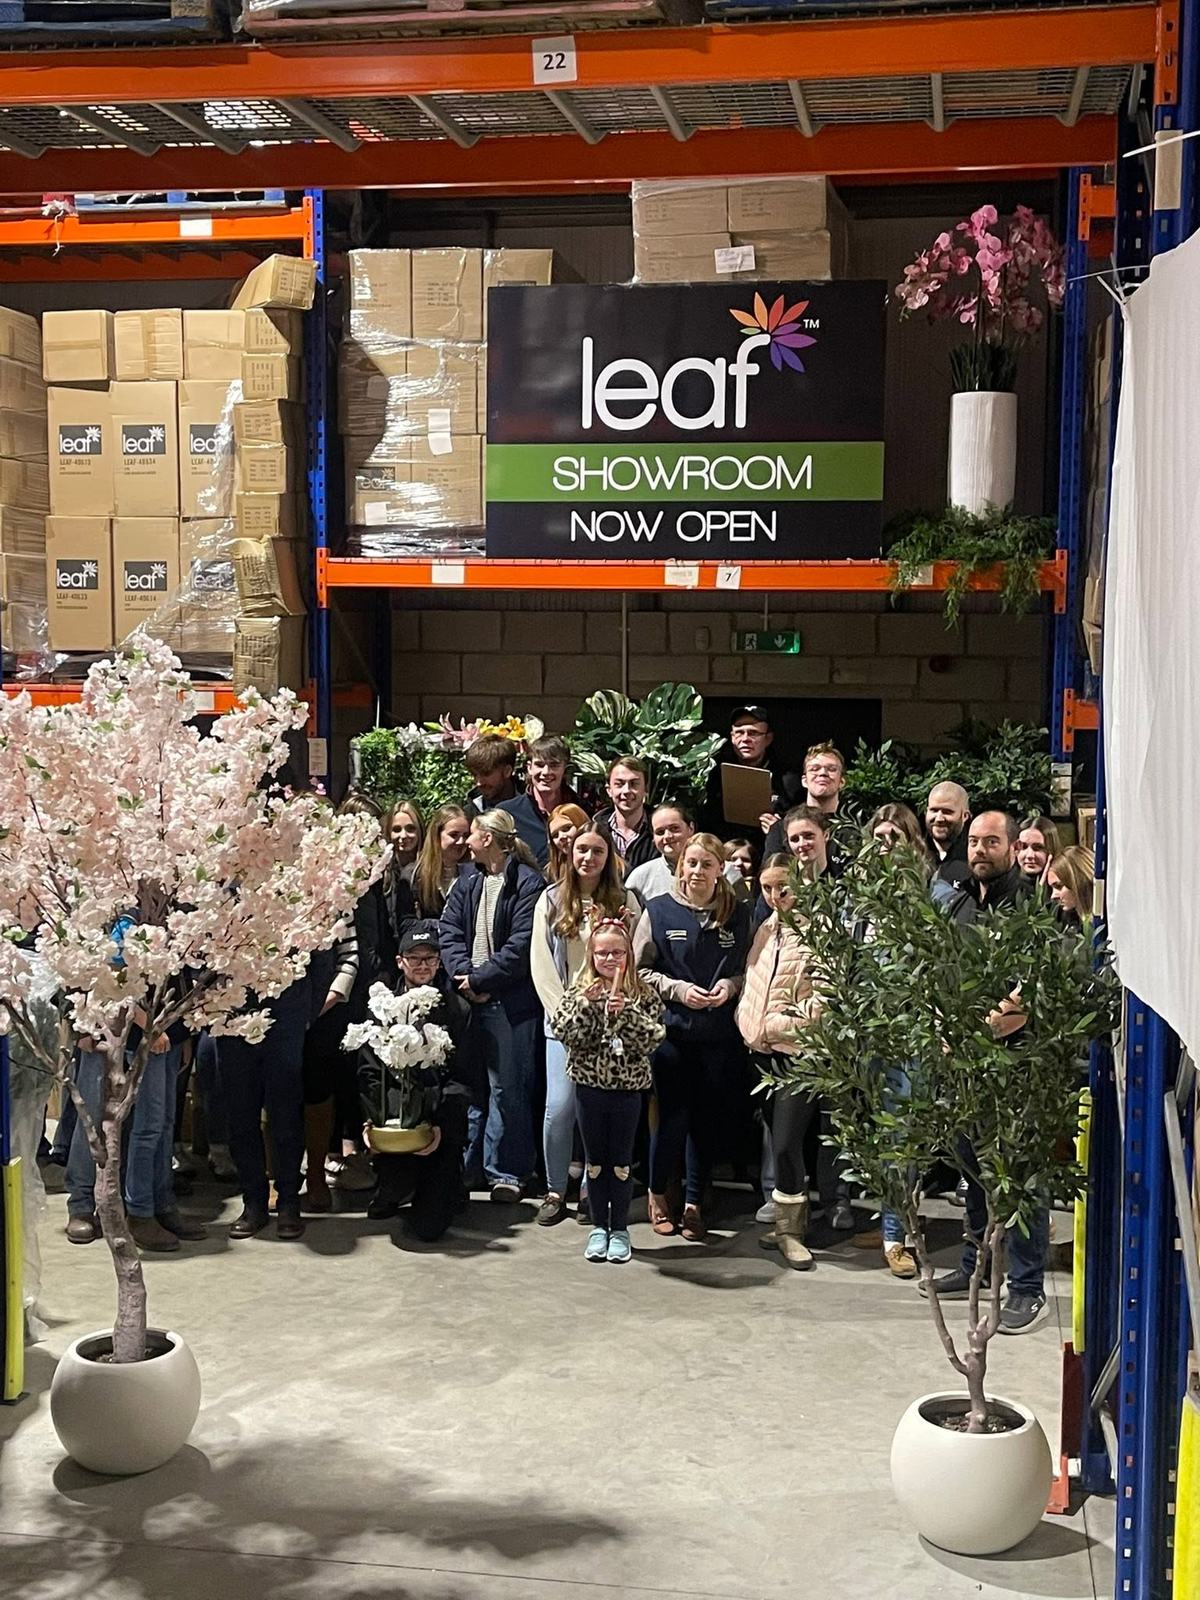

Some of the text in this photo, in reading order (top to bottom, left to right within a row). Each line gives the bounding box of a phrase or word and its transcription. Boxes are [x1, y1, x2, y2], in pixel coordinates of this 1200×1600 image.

[543, 53, 566, 70] 22
[803, 319, 820, 329] TM
[581, 333, 771, 431] leaf
[60, 434, 92, 453] leaf
[124, 434, 156, 453] leaf
[552, 454, 813, 491] SHOWROOM
[570, 510, 777, 542] NOW OPEN
[56, 568, 88, 588] leaf
[125, 570, 158, 589] leaf
